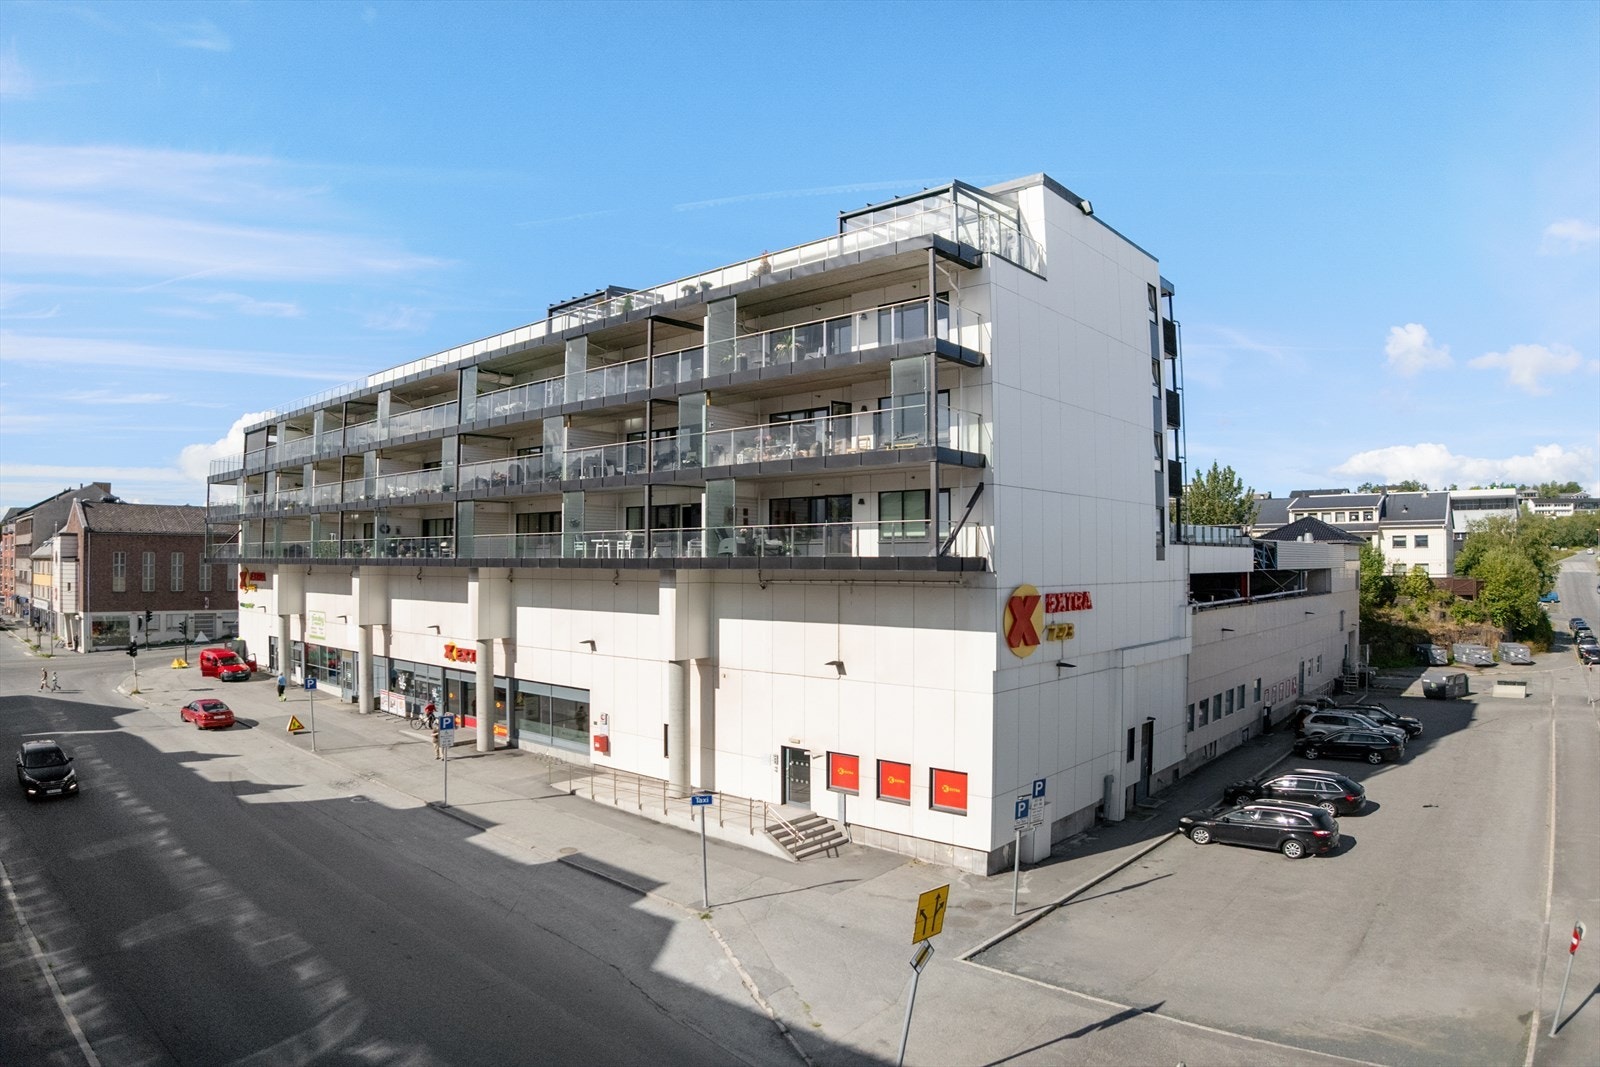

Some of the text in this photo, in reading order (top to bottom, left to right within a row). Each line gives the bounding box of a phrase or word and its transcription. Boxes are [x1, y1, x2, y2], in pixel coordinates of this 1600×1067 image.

[1045, 591, 1092, 613] EXTRA
[456, 647, 476, 663] EXT
[443, 718, 451, 728] P
[1035, 781, 1043, 796] P
[695, 796, 709, 804] Taxi
[1018, 802, 1026, 817] P
